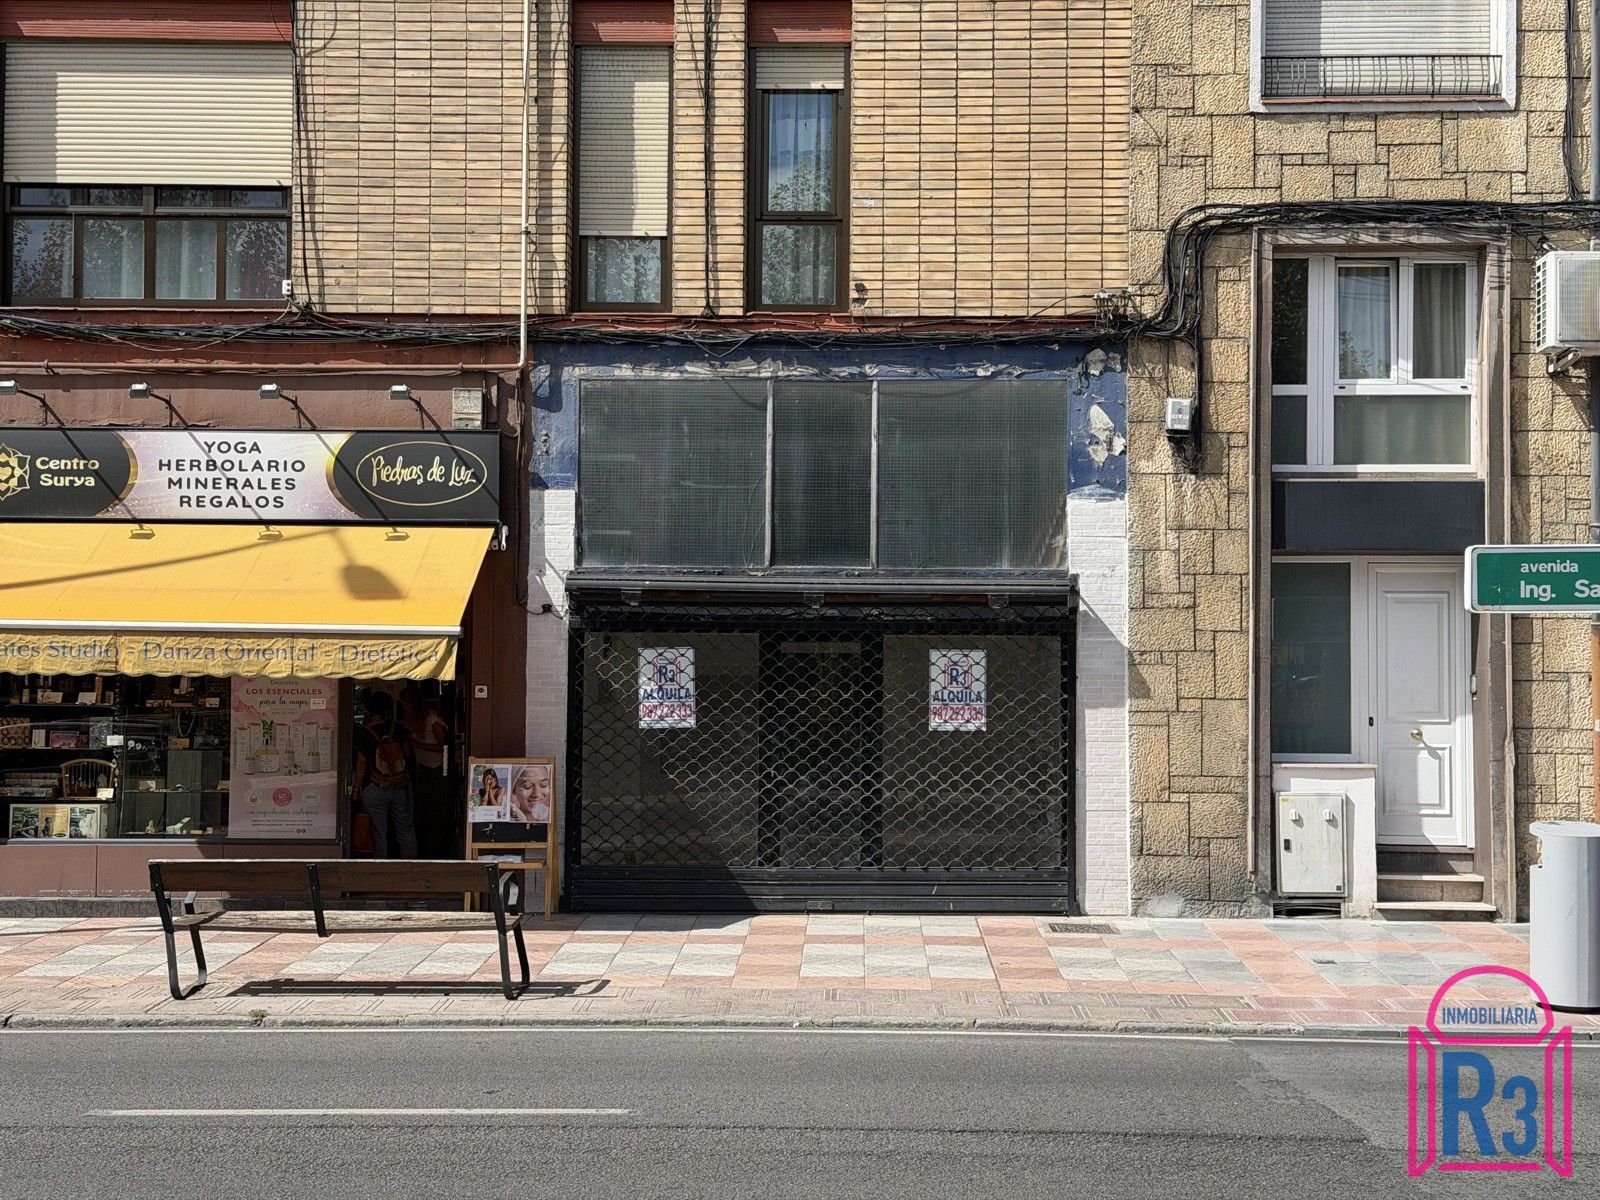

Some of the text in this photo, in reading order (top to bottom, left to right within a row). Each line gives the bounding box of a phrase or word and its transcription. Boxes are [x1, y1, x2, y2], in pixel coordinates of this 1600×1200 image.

[203, 441, 262, 454] YOGA
[35, 457, 100, 470] Centro
[158, 458, 306, 473] HERBOLARIO
[371, 455, 477, 487] Piedras de Luz
[39, 473, 96, 487] Surya
[167, 477, 297, 491] MINERALES
[179, 495, 285, 509] REGALOS
[1520, 559, 1579, 573] avenida
[1520, 580, 1557, 602] Ing.
[48, 639, 119, 660] Studio
[144, 641, 215, 661] Danza
[224, 643, 316, 664] Oriental
[339, 644, 438, 664] Dietética
[659, 665, 676, 683] R3
[949, 667, 967, 686] R3
[642, 687, 692, 700] ALQUILA
[932, 690, 983, 702] ALQUILA
